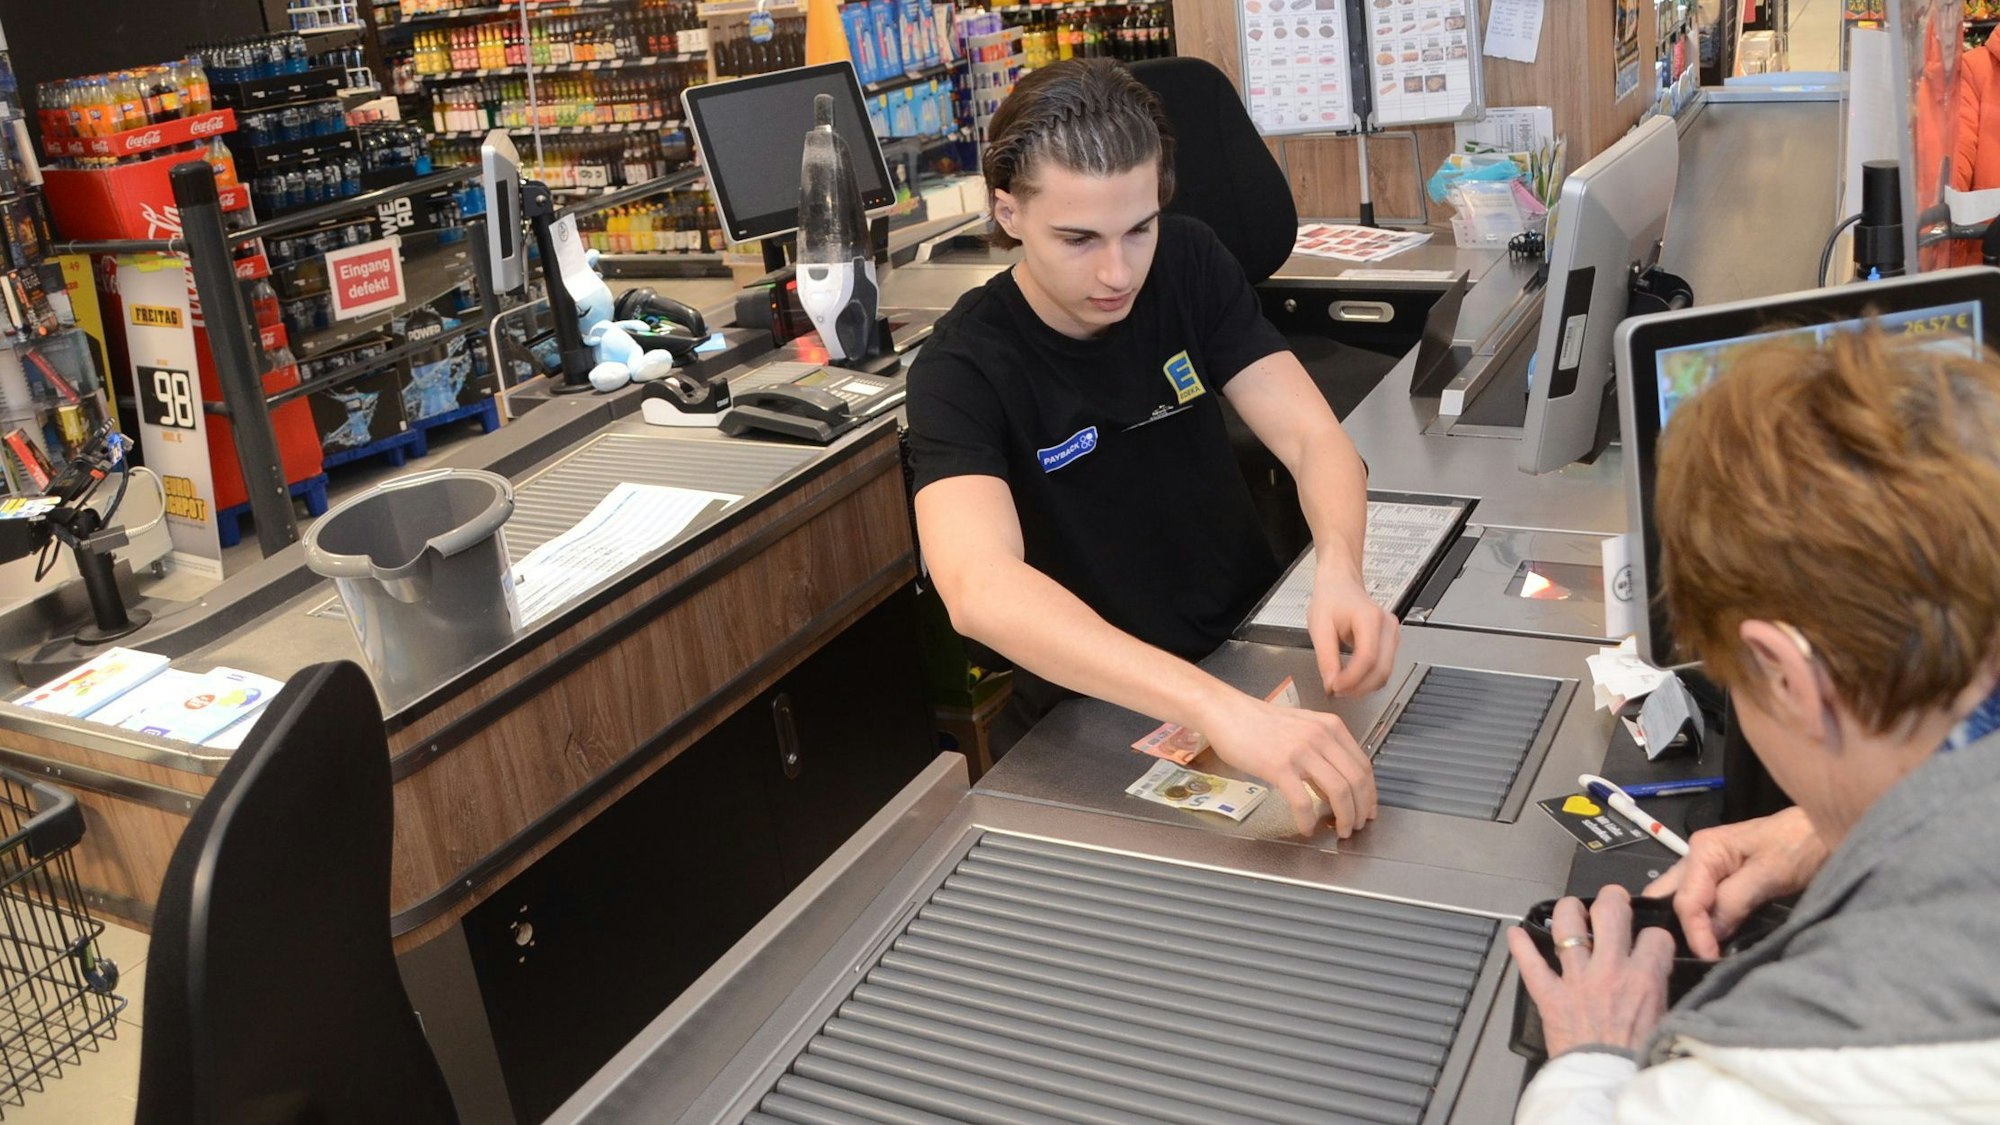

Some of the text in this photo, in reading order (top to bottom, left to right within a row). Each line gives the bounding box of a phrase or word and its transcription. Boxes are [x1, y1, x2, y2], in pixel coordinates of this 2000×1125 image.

[339, 257, 391, 280] Eingang
[348, 278, 390, 299] defekt!
[135, 307, 178, 324] FREITAG
[408, 325, 441, 341] POWER
[1168, 357, 1195, 390] E
[154, 371, 194, 427] 98
[1179, 386, 1201, 400] EDEKA
[1044, 442, 1080, 465] PAYBACK
[163, 476, 192, 499] EURO
